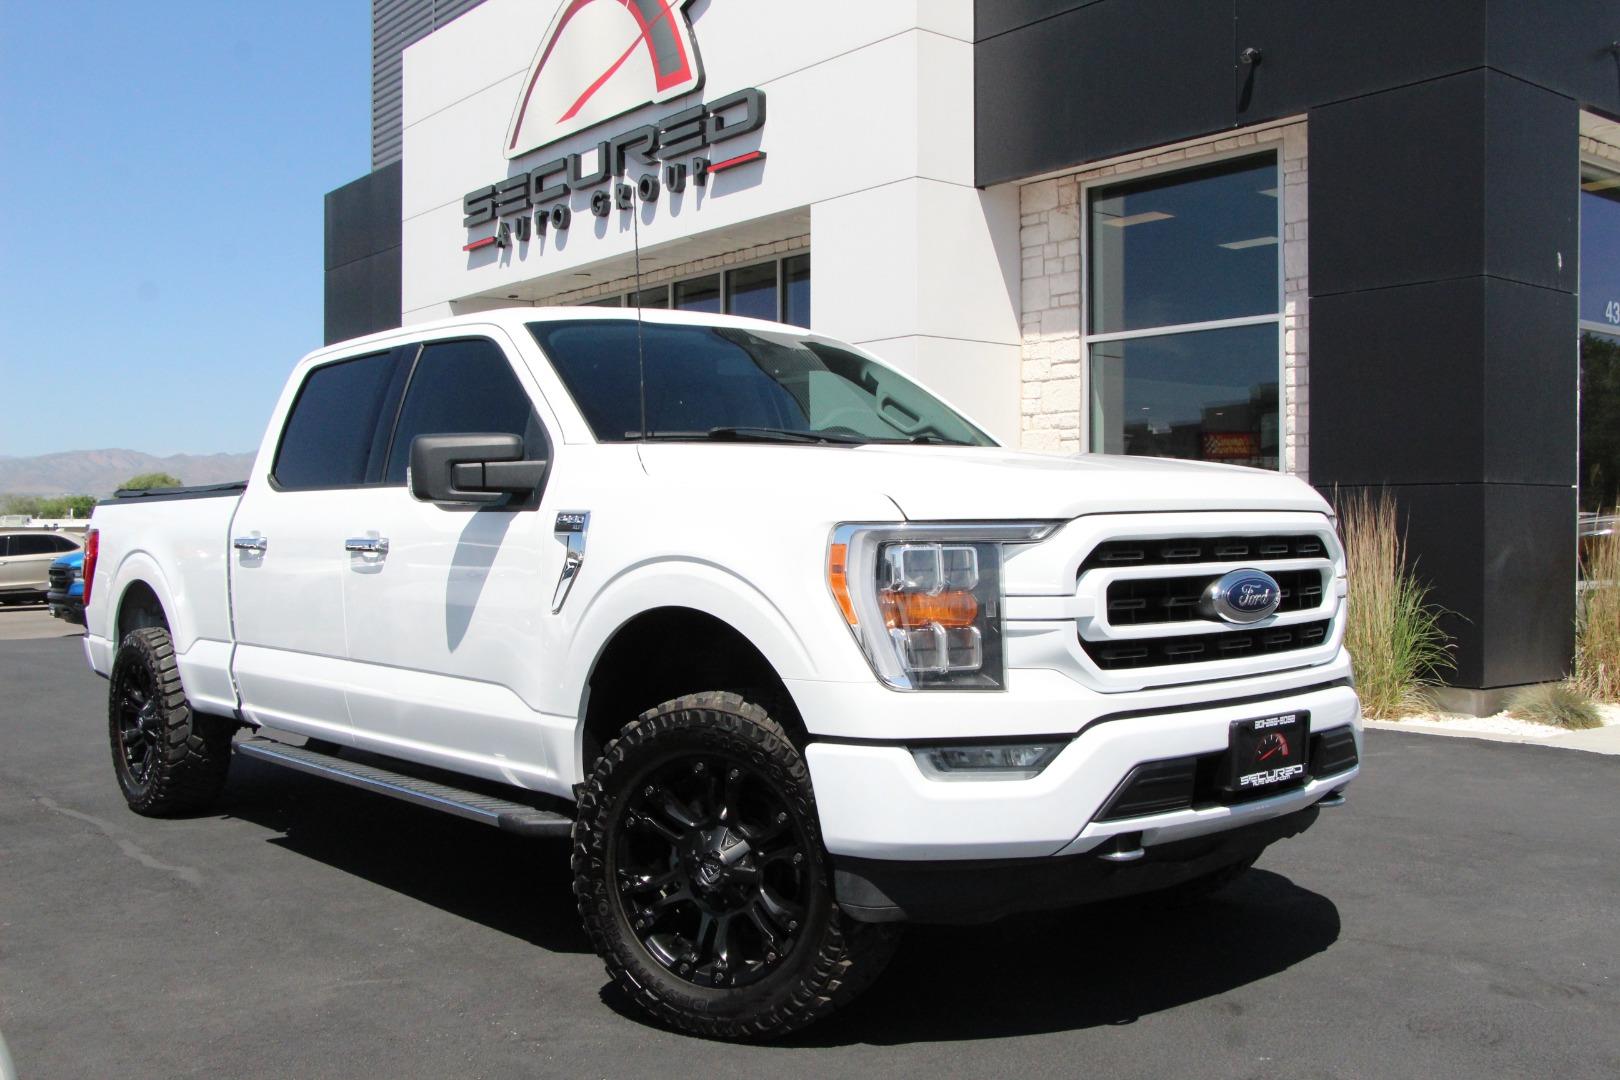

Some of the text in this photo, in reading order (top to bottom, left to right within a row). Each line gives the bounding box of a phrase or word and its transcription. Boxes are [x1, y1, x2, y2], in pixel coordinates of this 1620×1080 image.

[463, 87, 766, 228] SECURED
[495, 157, 711, 248] AUTO GROUP
[1239, 583, 1270, 607] Ford
[1240, 764, 1303, 786] SECURED
